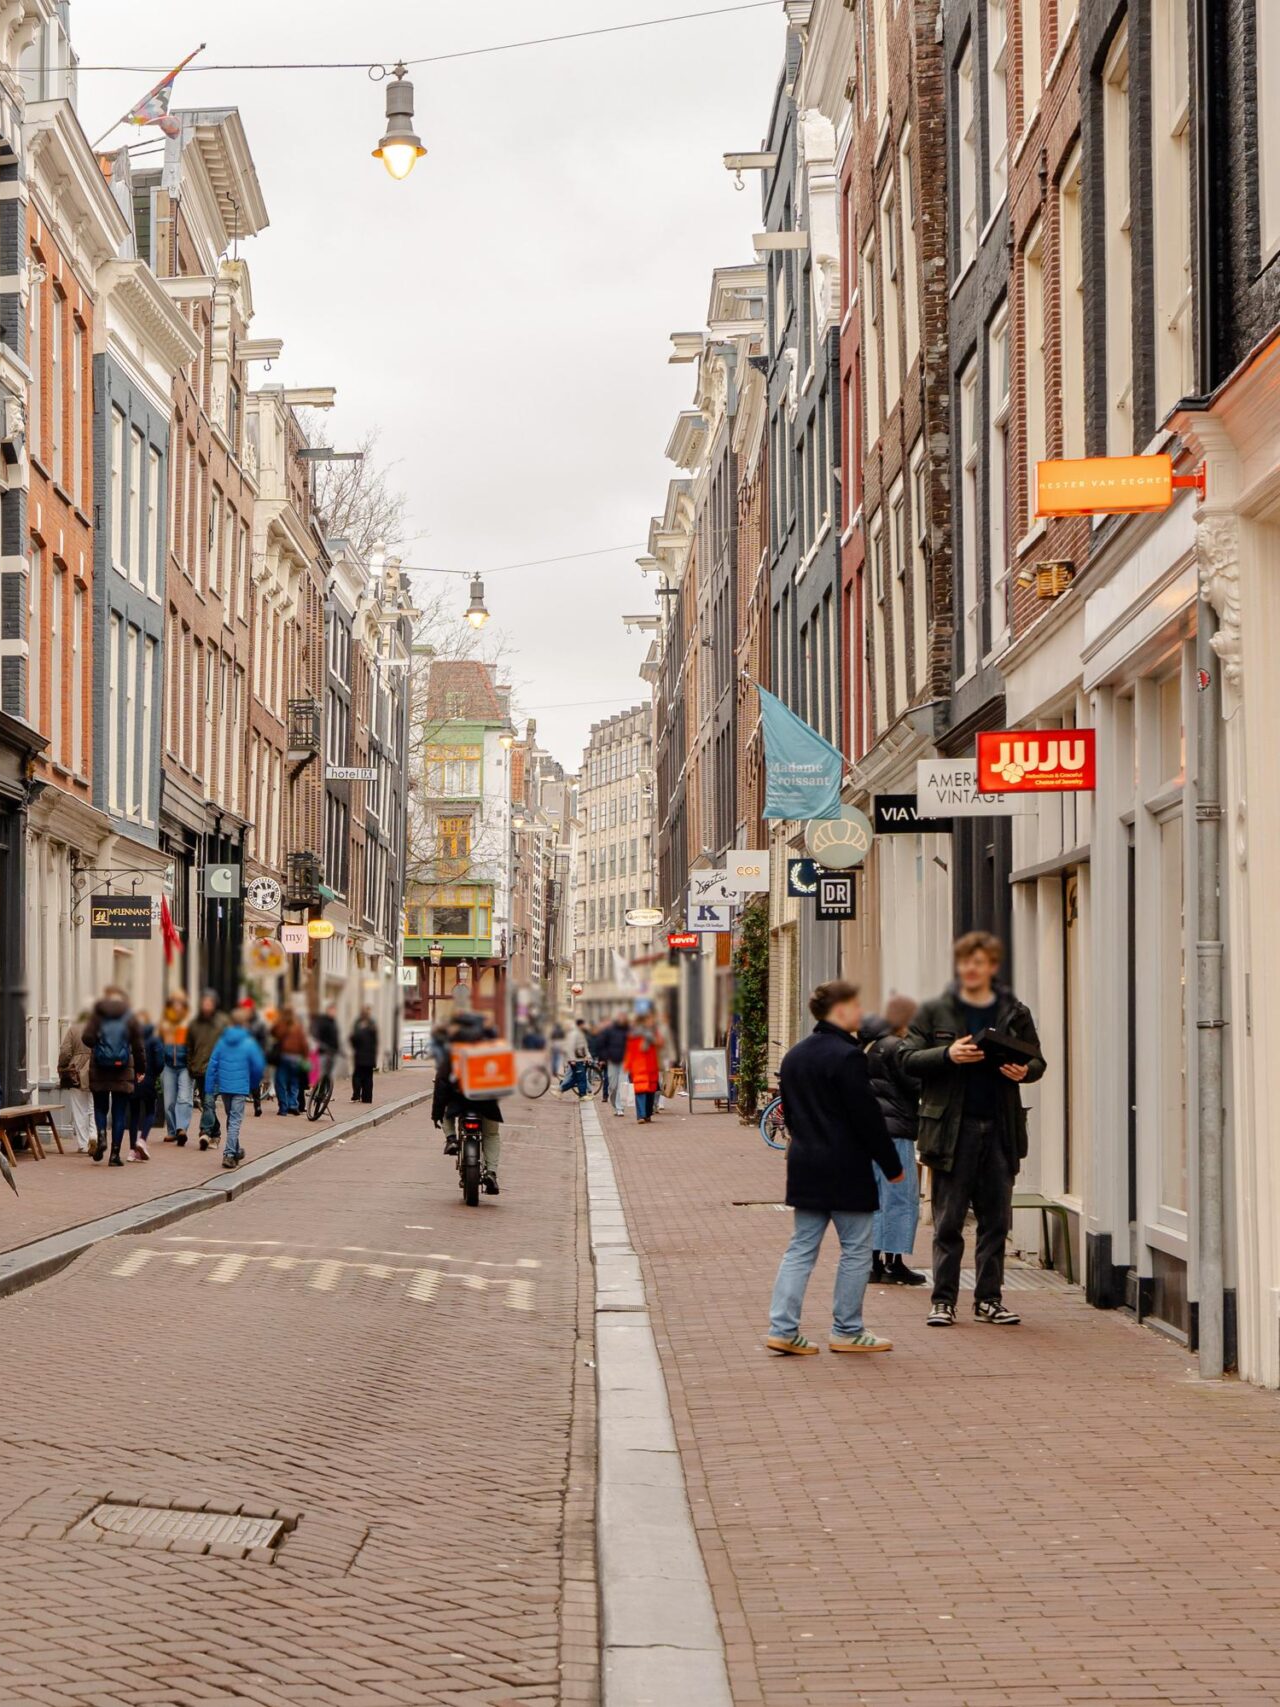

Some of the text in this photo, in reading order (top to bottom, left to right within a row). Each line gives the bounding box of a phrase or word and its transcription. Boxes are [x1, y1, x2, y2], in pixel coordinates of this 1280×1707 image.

[1039, 480, 1085, 489] HESTER
[1121, 476, 1170, 486] EEGHEN
[990, 740, 1085, 772] JUJU
[331, 769, 359, 778] hotel
[928, 772, 978, 787] AMERI
[936, 789, 1004, 804] VINTAGE
[881, 807, 909, 820] VIA
[736, 866, 760, 876] COS
[826, 885, 846, 901] DR
[697, 905, 720, 920] K
